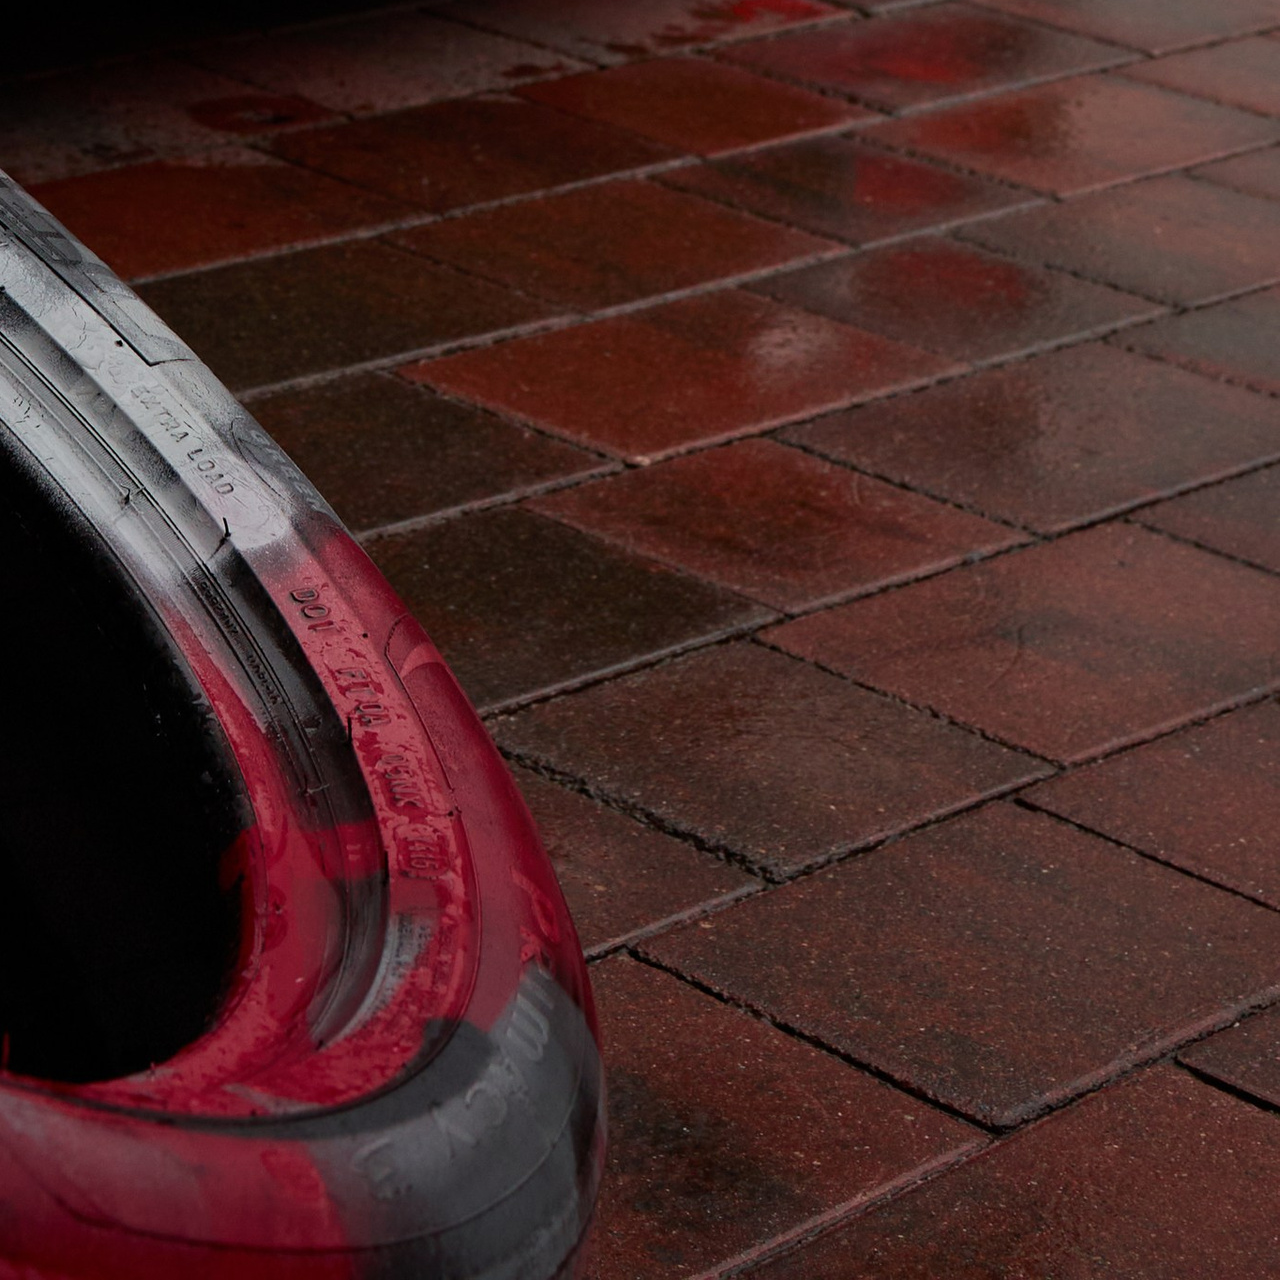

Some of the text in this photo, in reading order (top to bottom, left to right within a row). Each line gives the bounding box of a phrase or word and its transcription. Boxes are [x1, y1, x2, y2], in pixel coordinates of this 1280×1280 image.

[129, 384, 237, 498] EXTRA LOAD
[289, 586, 332, 634] DOT
